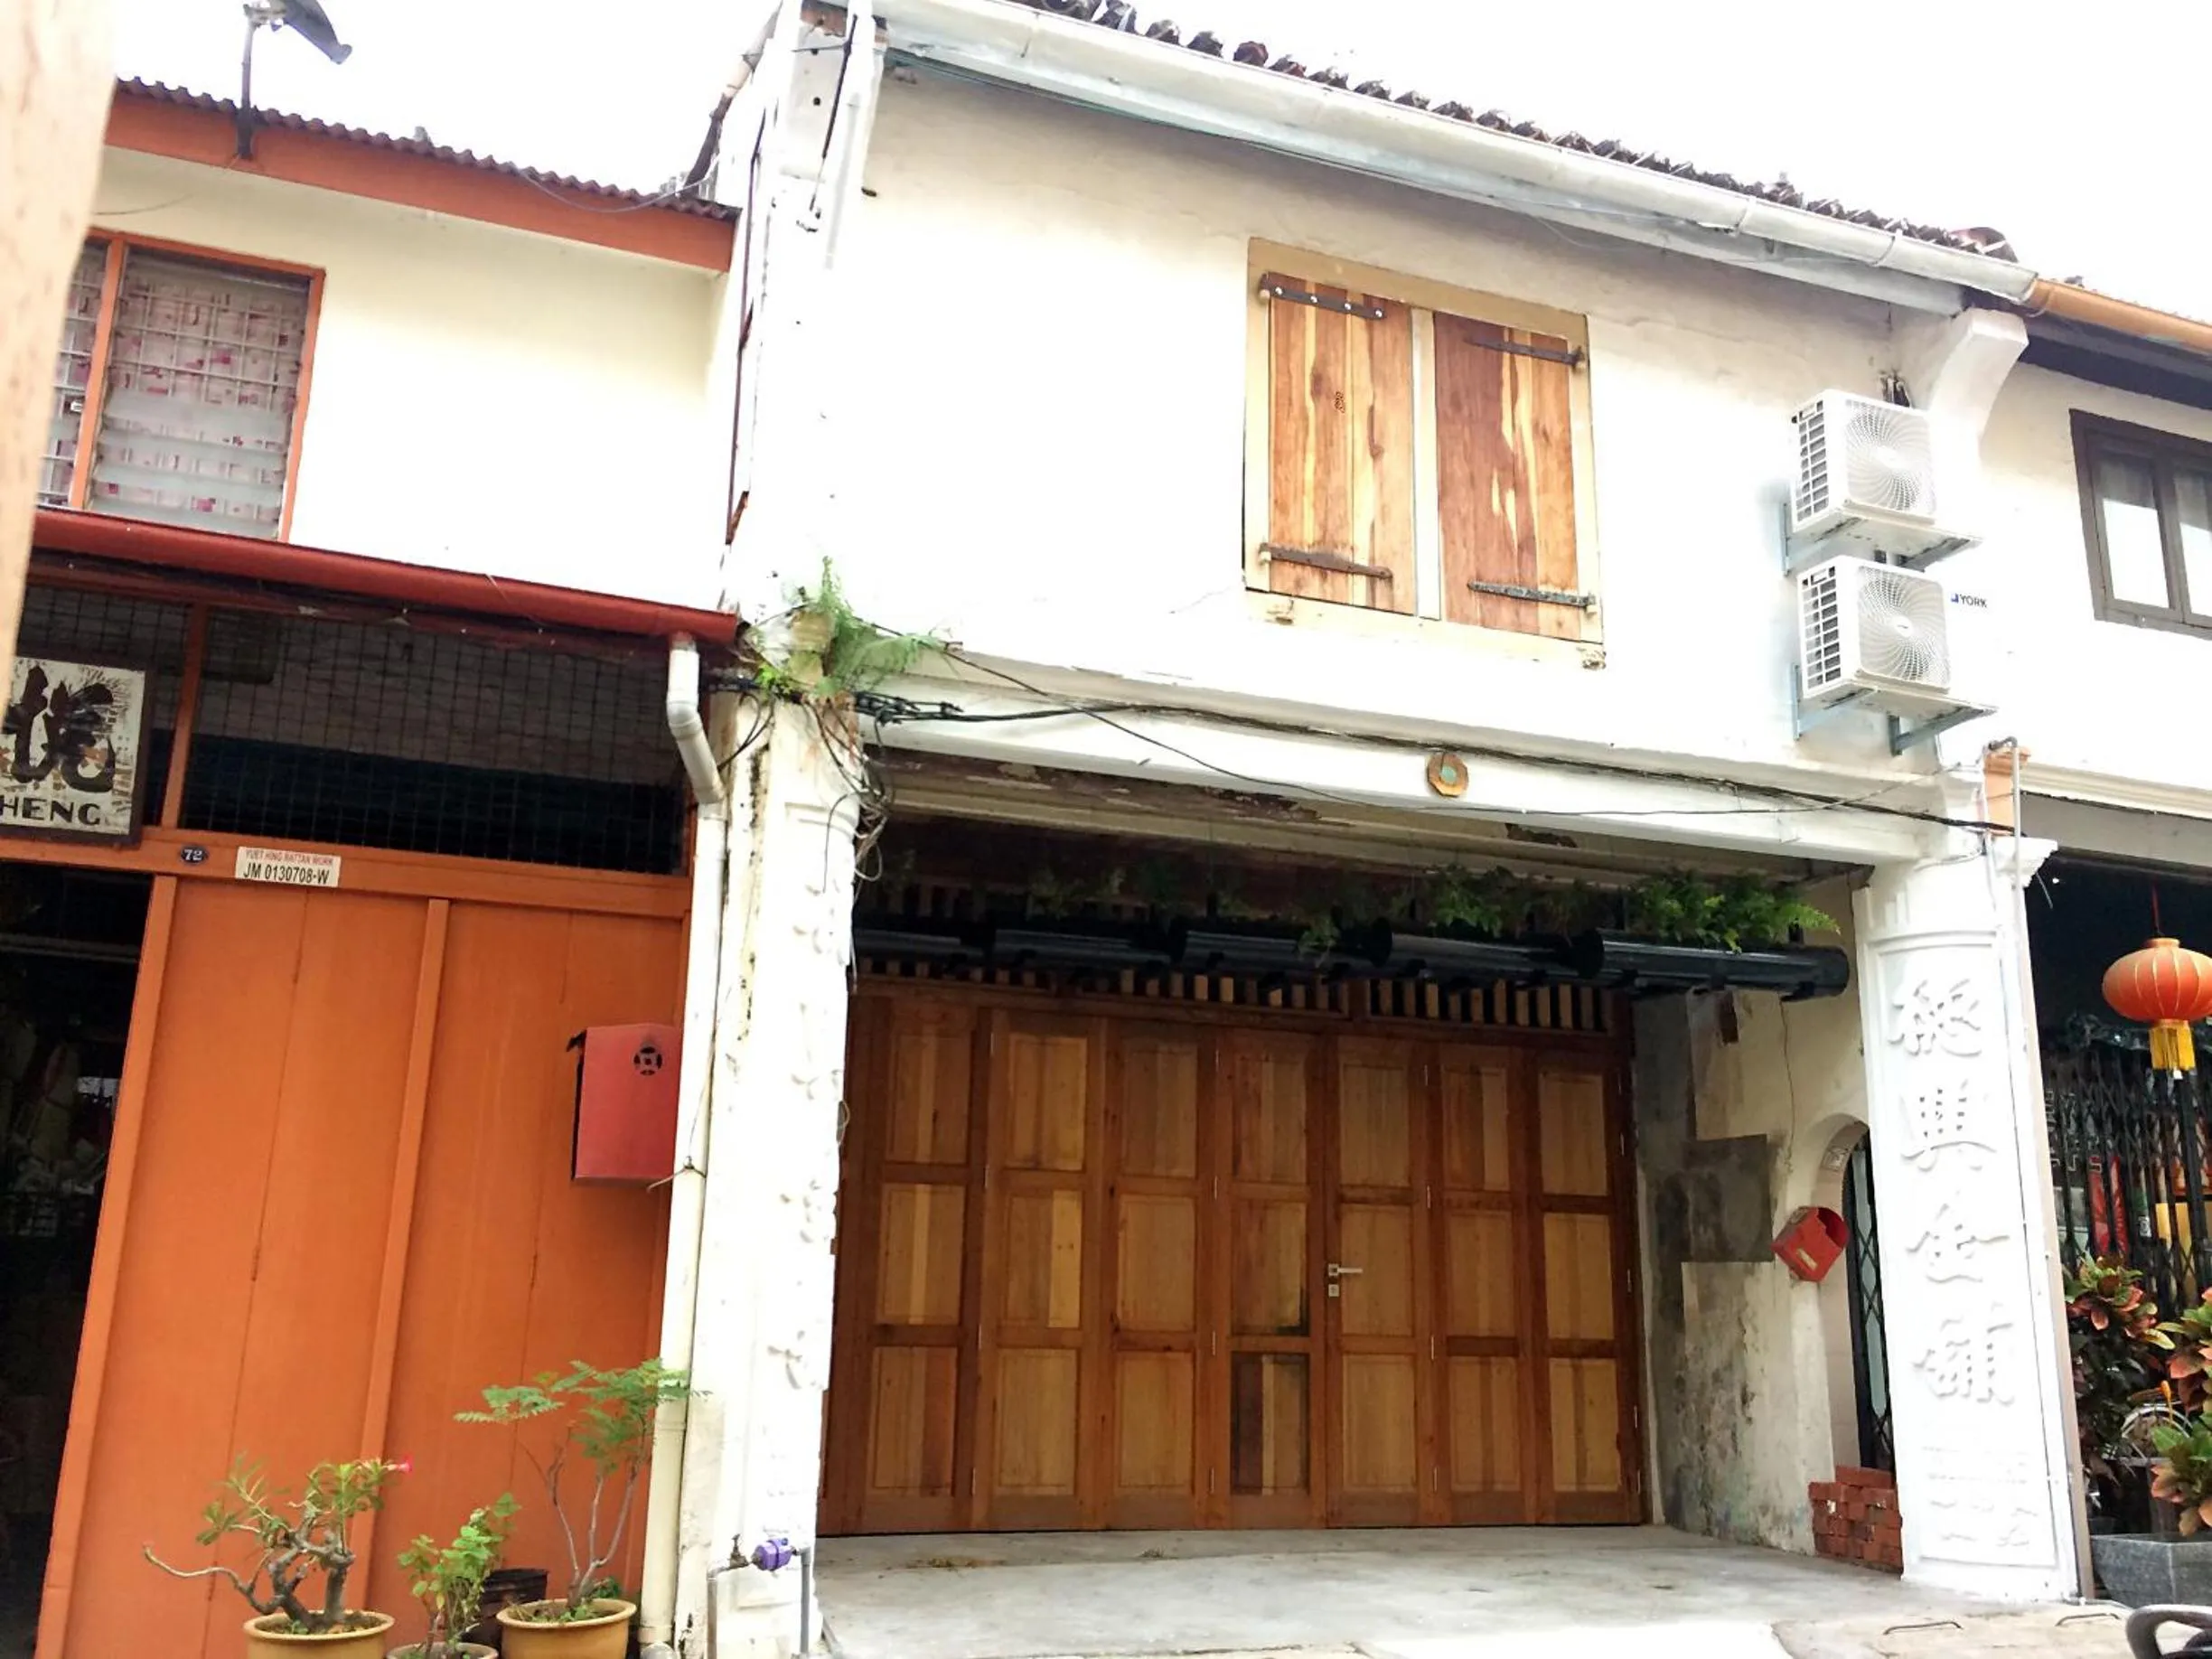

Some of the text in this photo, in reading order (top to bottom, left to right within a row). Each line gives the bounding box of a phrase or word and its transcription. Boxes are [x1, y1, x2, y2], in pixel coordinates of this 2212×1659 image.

[184, 849, 202, 860] 72
[243, 862, 329, 884] JM 0130708-W
